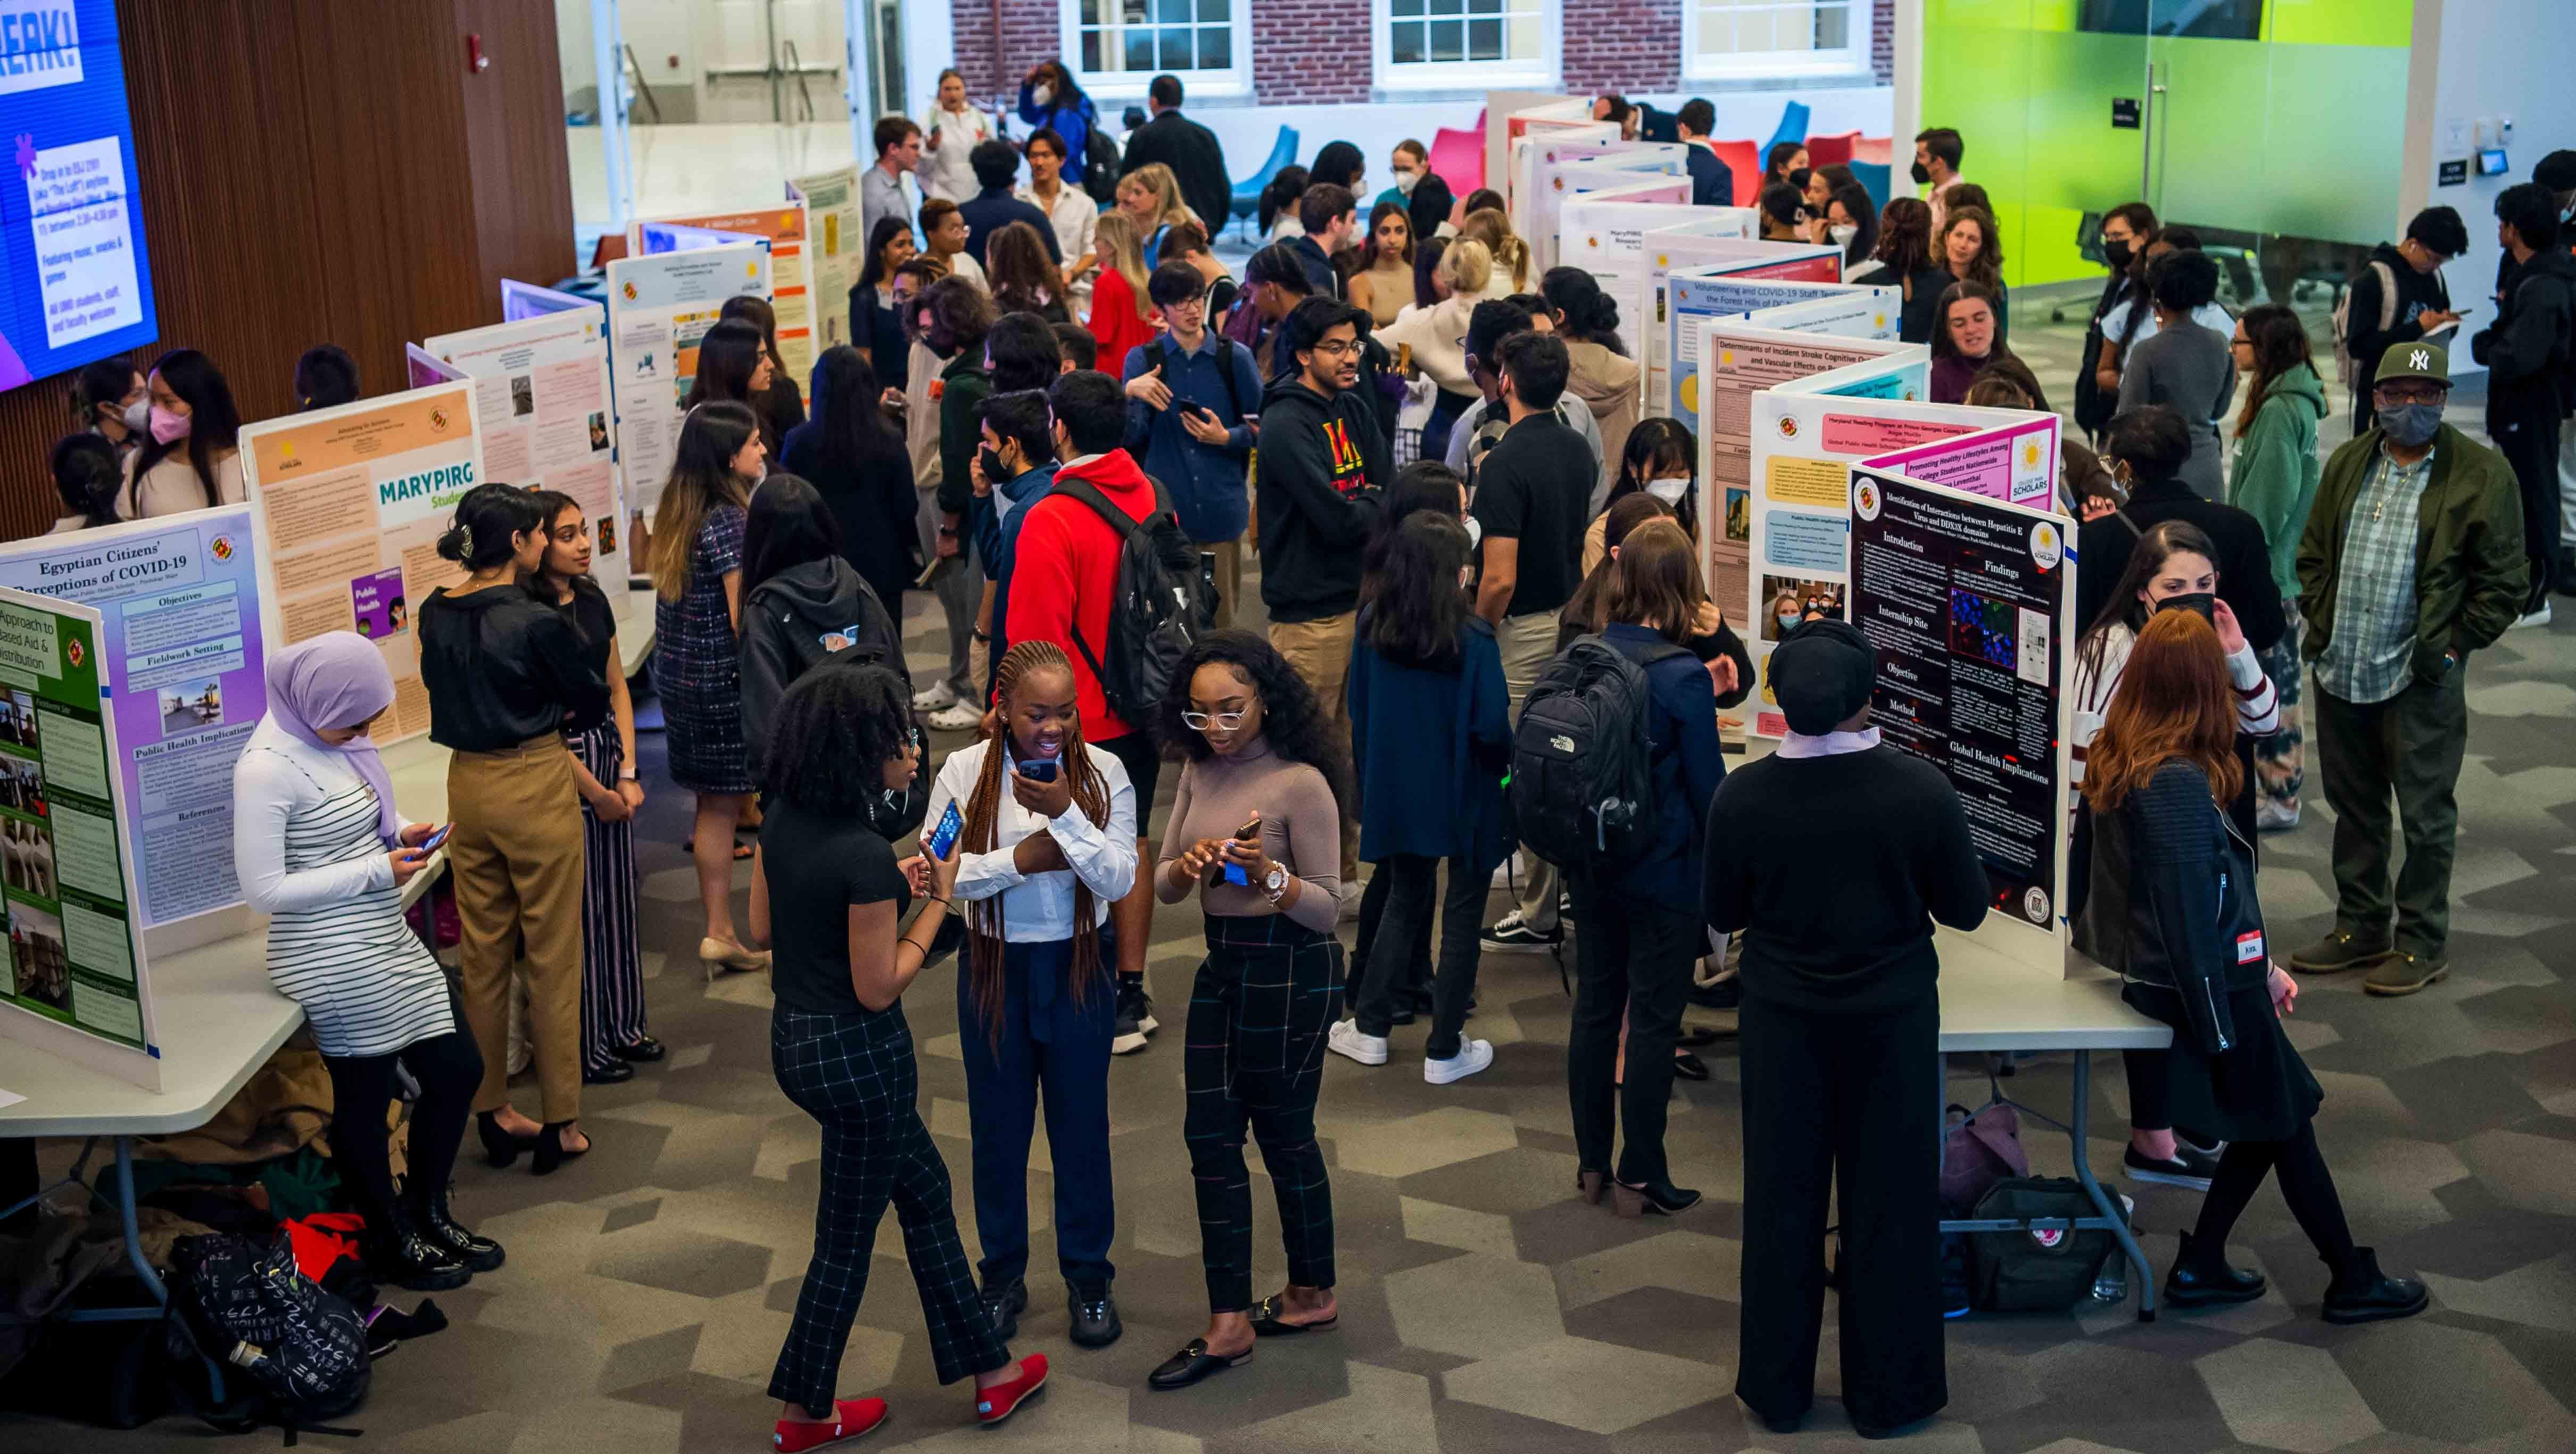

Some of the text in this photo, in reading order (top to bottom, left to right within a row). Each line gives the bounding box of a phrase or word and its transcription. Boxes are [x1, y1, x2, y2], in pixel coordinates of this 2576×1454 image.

[0, 9, 75, 76] EAK!
[1694, 282, 1741, 295] Volunteering
[1758, 287, 1797, 297] COVID-19
[1707, 295, 1719, 304] the
[1720, 296, 1743, 306] Forest
[1745, 297, 1760, 307] Hills
[1762, 298, 1771, 307] of
[1719, 341, 1763, 353] Determinants
[1772, 346, 1799, 358] Incident
[1801, 350, 1823, 360] Stroke
[1825, 352, 1856, 363] Cognitive
[2409, 349, 2430, 370] NY
[1765, 358, 1792, 368] Vascular
[1794, 361, 1815, 371] Effects
[1875, 420, 1895, 429] Program
[1920, 425, 1942, 434] Georges
[1943, 427, 1961, 436] County
[1909, 443, 2009, 472] Promoting Healthy Lifestyles Among
[1919, 457, 1998, 481] College Students Nationwide
[379, 462, 474, 505] MARYPIRG
[1953, 474, 1981, 488] Leventhal
[2014, 481, 2048, 496] SCHOLARS
[1887, 492, 1919, 509] Identification
[1927, 505, 1960, 521] Interactions
[1961, 513, 1986, 527] between
[1987, 519, 2016, 534] Hepatitis
[2017, 527, 2023, 535] E
[1914, 511, 1928, 523] Virus
[1929, 518, 1940, 526] and
[1941, 519, 1962, 532] DDX3X
[1963, 525, 1989, 539] domains
[1883, 531, 1924, 554] Introduction
[39, 541, 161, 575] Egyptian Citizens'
[102, 570, 116, 584] of
[119, 555, 187, 580] COVID-19
[1984, 560, 2019, 580] Findings
[159, 592, 202, 607] Objectives
[355, 586, 377, 599] Public
[358, 600, 380, 613] Health
[1878, 604, 1928, 630] Internship Site
[44, 622, 54, 635] to
[24, 634, 39, 650] Aid
[42, 639, 48, 652] &
[0, 647, 44, 671] istribution
[147, 643, 224, 666] Fieldwork Setting
[1887, 662, 1918, 681] Objective
[1890, 698, 1915, 717] Method
[136, 725, 253, 758] Public Health Implications
[1950, 741, 1974, 758] Global
[1975, 749, 2001, 767] Health
[2002, 759, 2049, 785] Implications
[178, 805, 226, 822] References
